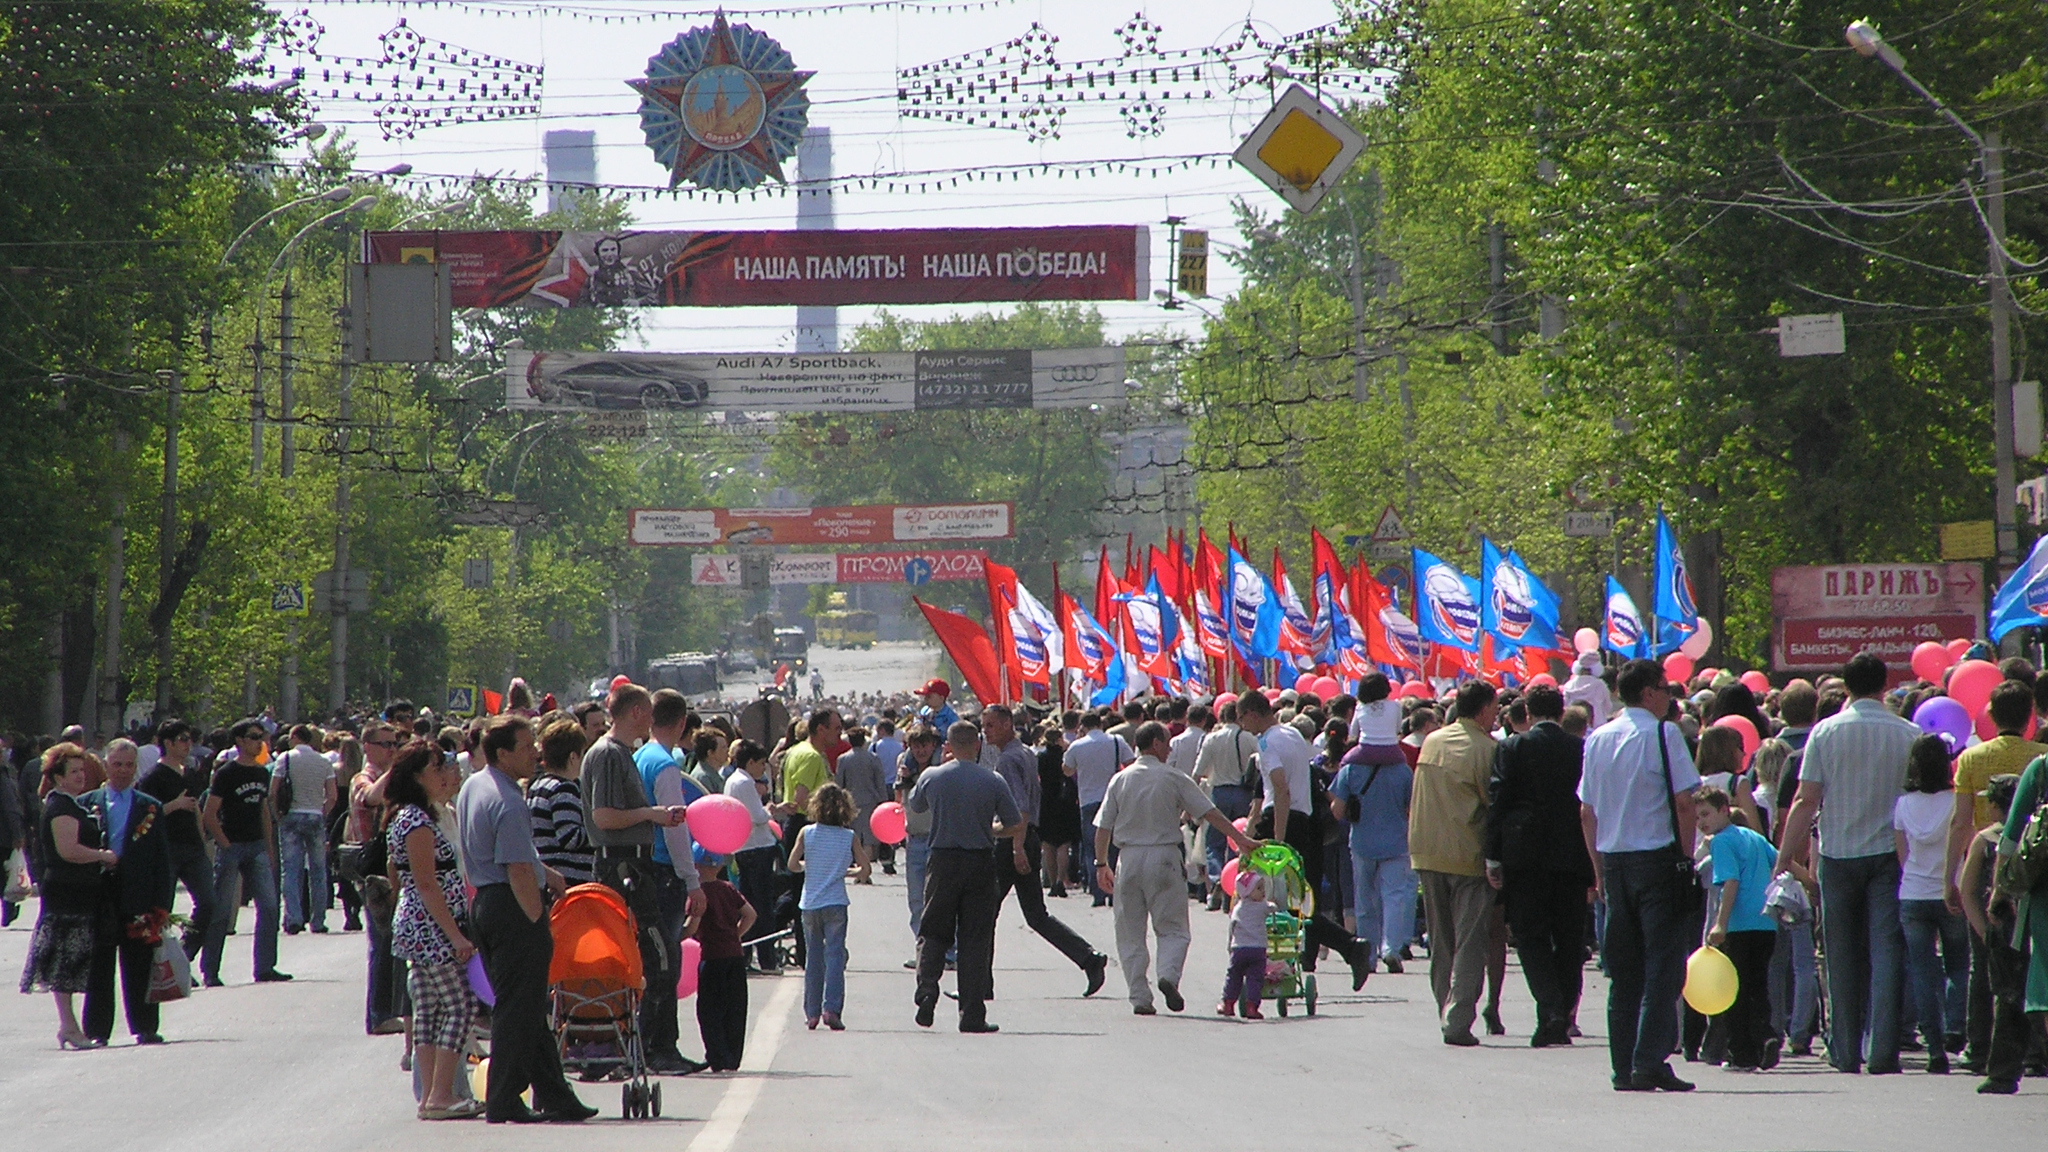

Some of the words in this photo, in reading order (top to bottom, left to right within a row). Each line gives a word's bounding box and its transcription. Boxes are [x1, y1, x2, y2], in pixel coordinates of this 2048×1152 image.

[734, 256, 801, 281] НАША
[805, 255, 906, 280] ПАМЯТЬ!
[922, 254, 992, 279] НАША
[996, 251, 1107, 278] ПОБЕДА!
[1181, 255, 1206, 269] 227
[716, 357, 755, 369] Audi
[761, 357, 784, 369] A7
[789, 356, 882, 371] Sportback.
[919, 356, 954, 368] Ауди
[956, 355, 1007, 368] Сервис
[919, 385, 968, 397] (4732)
[971, 385, 989, 395] 21
[994, 383, 1029, 394] 7777
[828, 526, 849, 538] 290
[1825, 570, 1940, 596] ПАРИЖЪ
